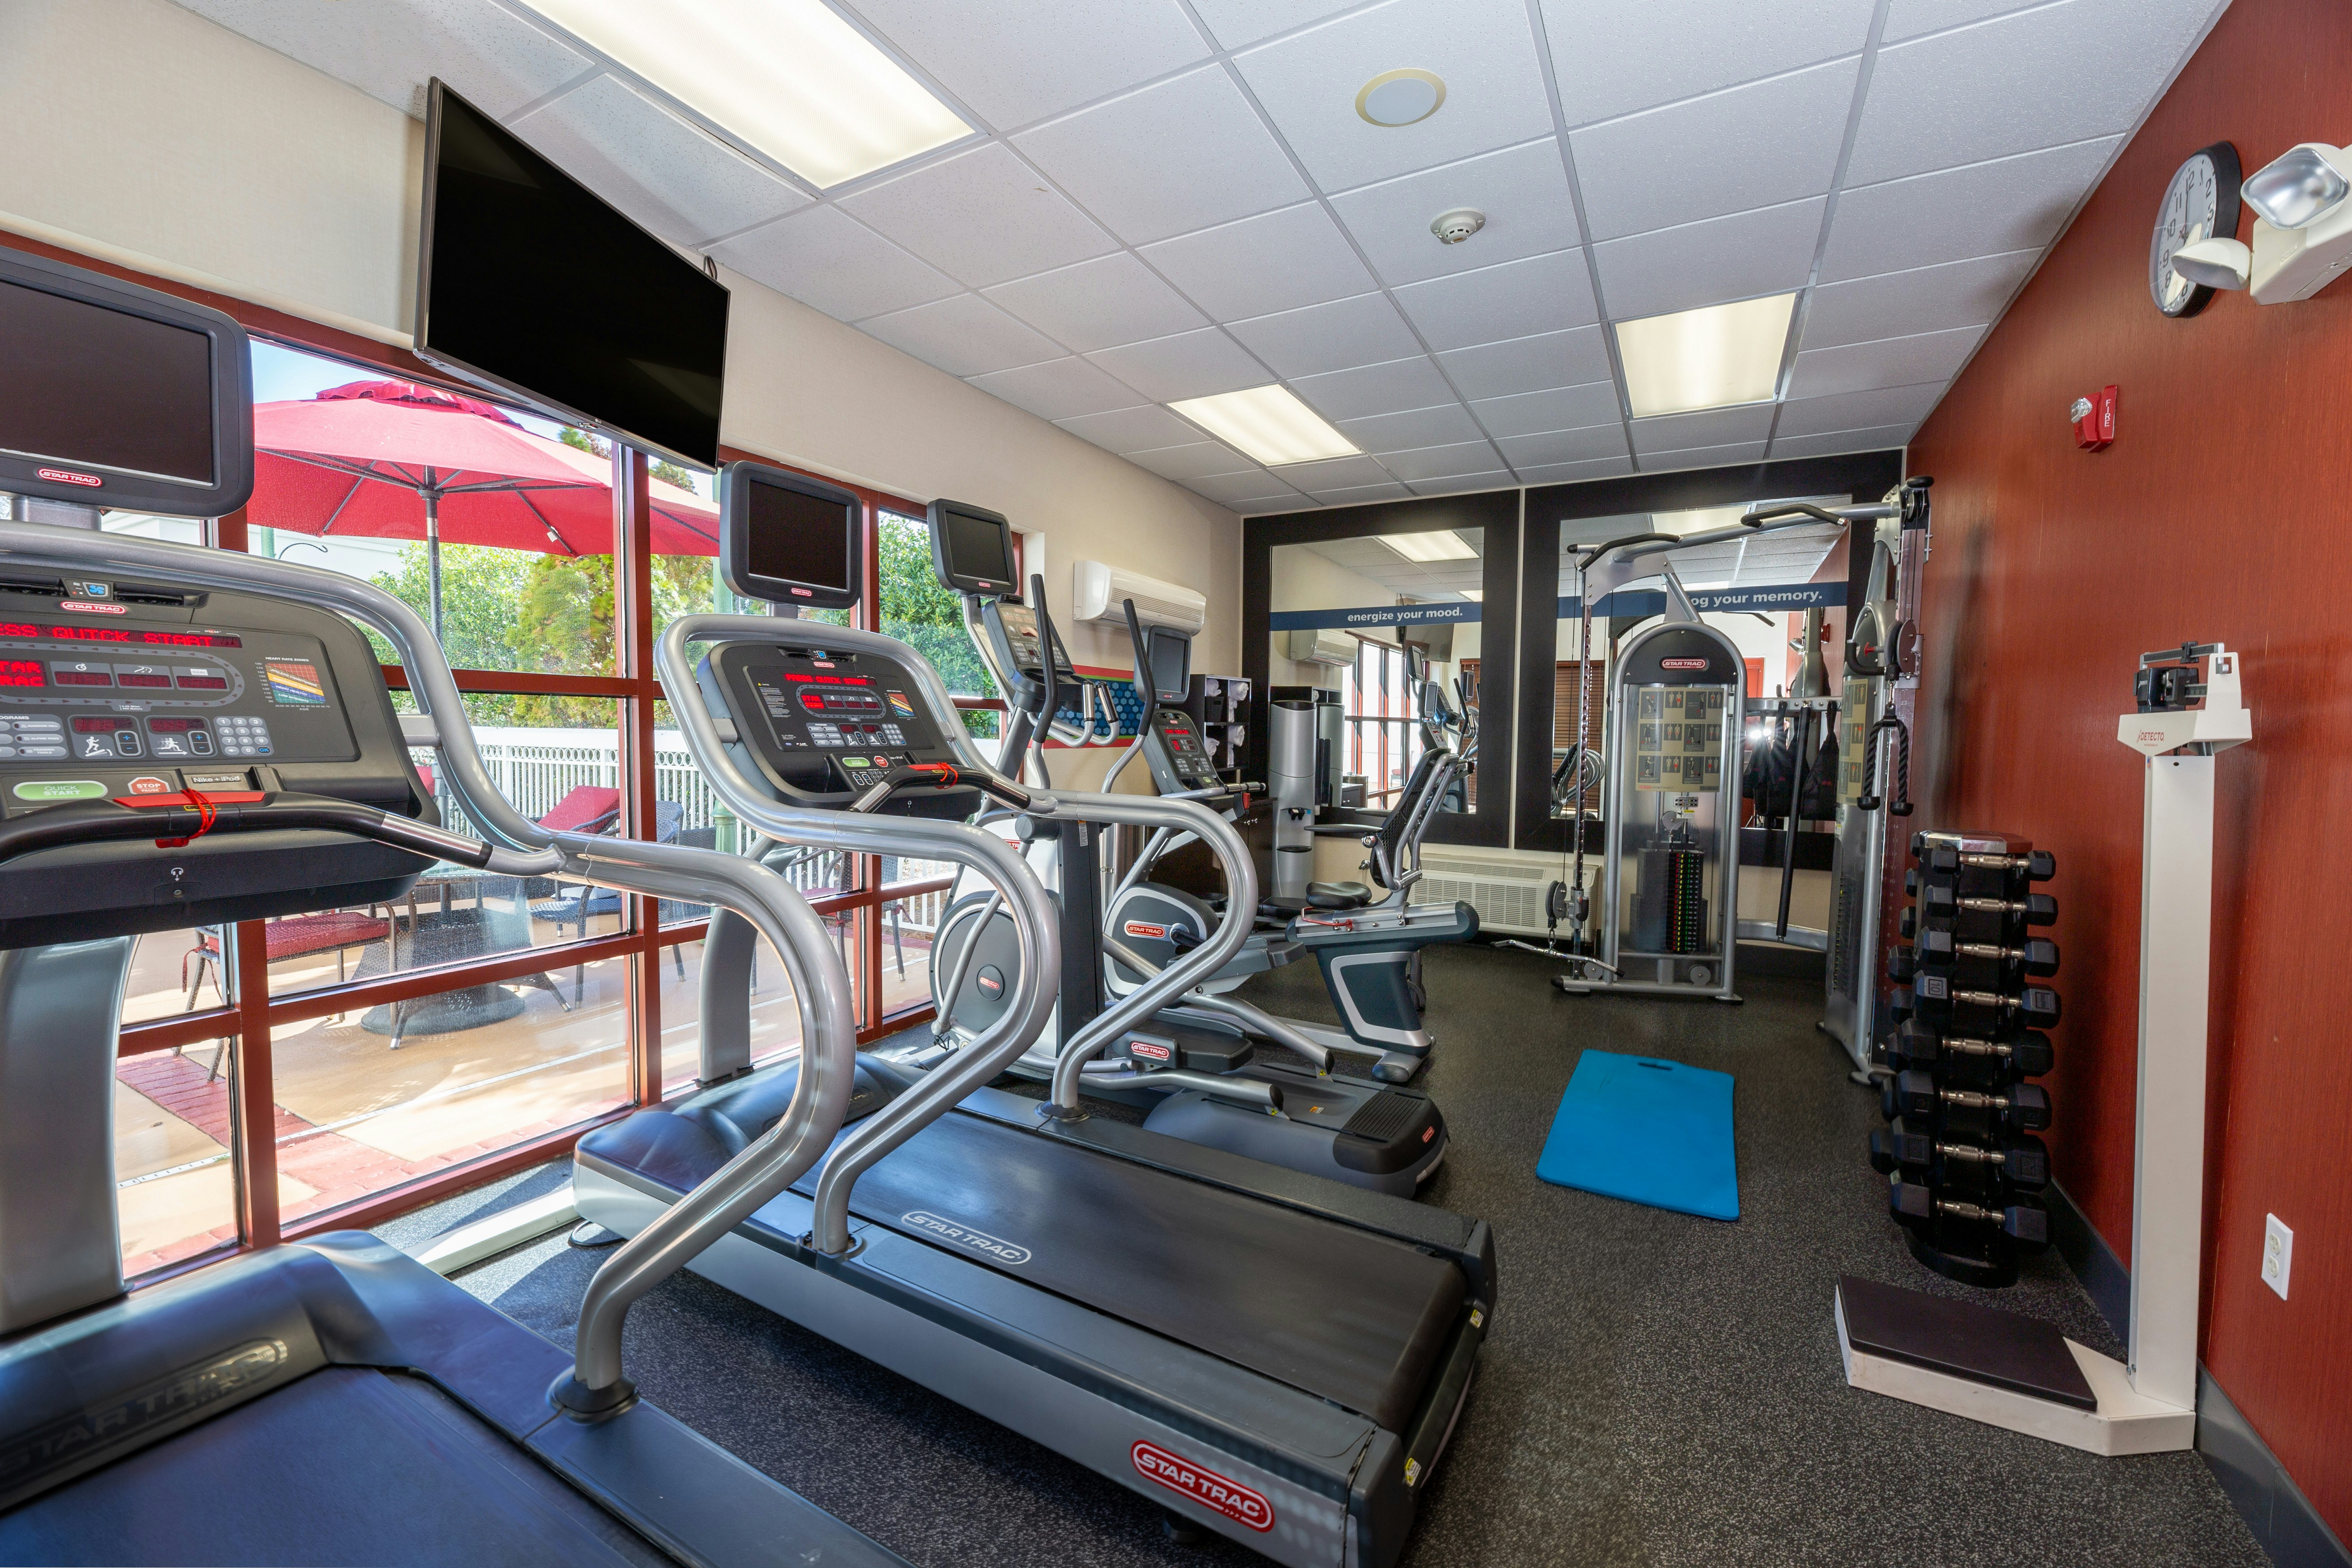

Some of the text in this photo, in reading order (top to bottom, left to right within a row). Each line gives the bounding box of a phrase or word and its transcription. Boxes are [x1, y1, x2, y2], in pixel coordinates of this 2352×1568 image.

[2206, 178, 2212, 198] 2
[2175, 192, 2182, 214] 11
[2207, 201, 2214, 222] 3
[2166, 218, 2176, 241] 10
[2165, 270, 2171, 289] 8
[41, 471, 96, 484] STAR TRAC
[1688, 591, 1823, 607] og your memory.
[1348, 607, 1463, 622] energize your mood.
[52, 627, 129, 642] QUICK
[144, 633, 213, 647] START
[270, 669, 317, 687] ATHLETIC CONDITIONING
[2141, 732, 2164, 741] DETECTO
[905, 1215, 1021, 1258] STAR TRAC
[1137, 1453, 1260, 1517] STAR TRAC
